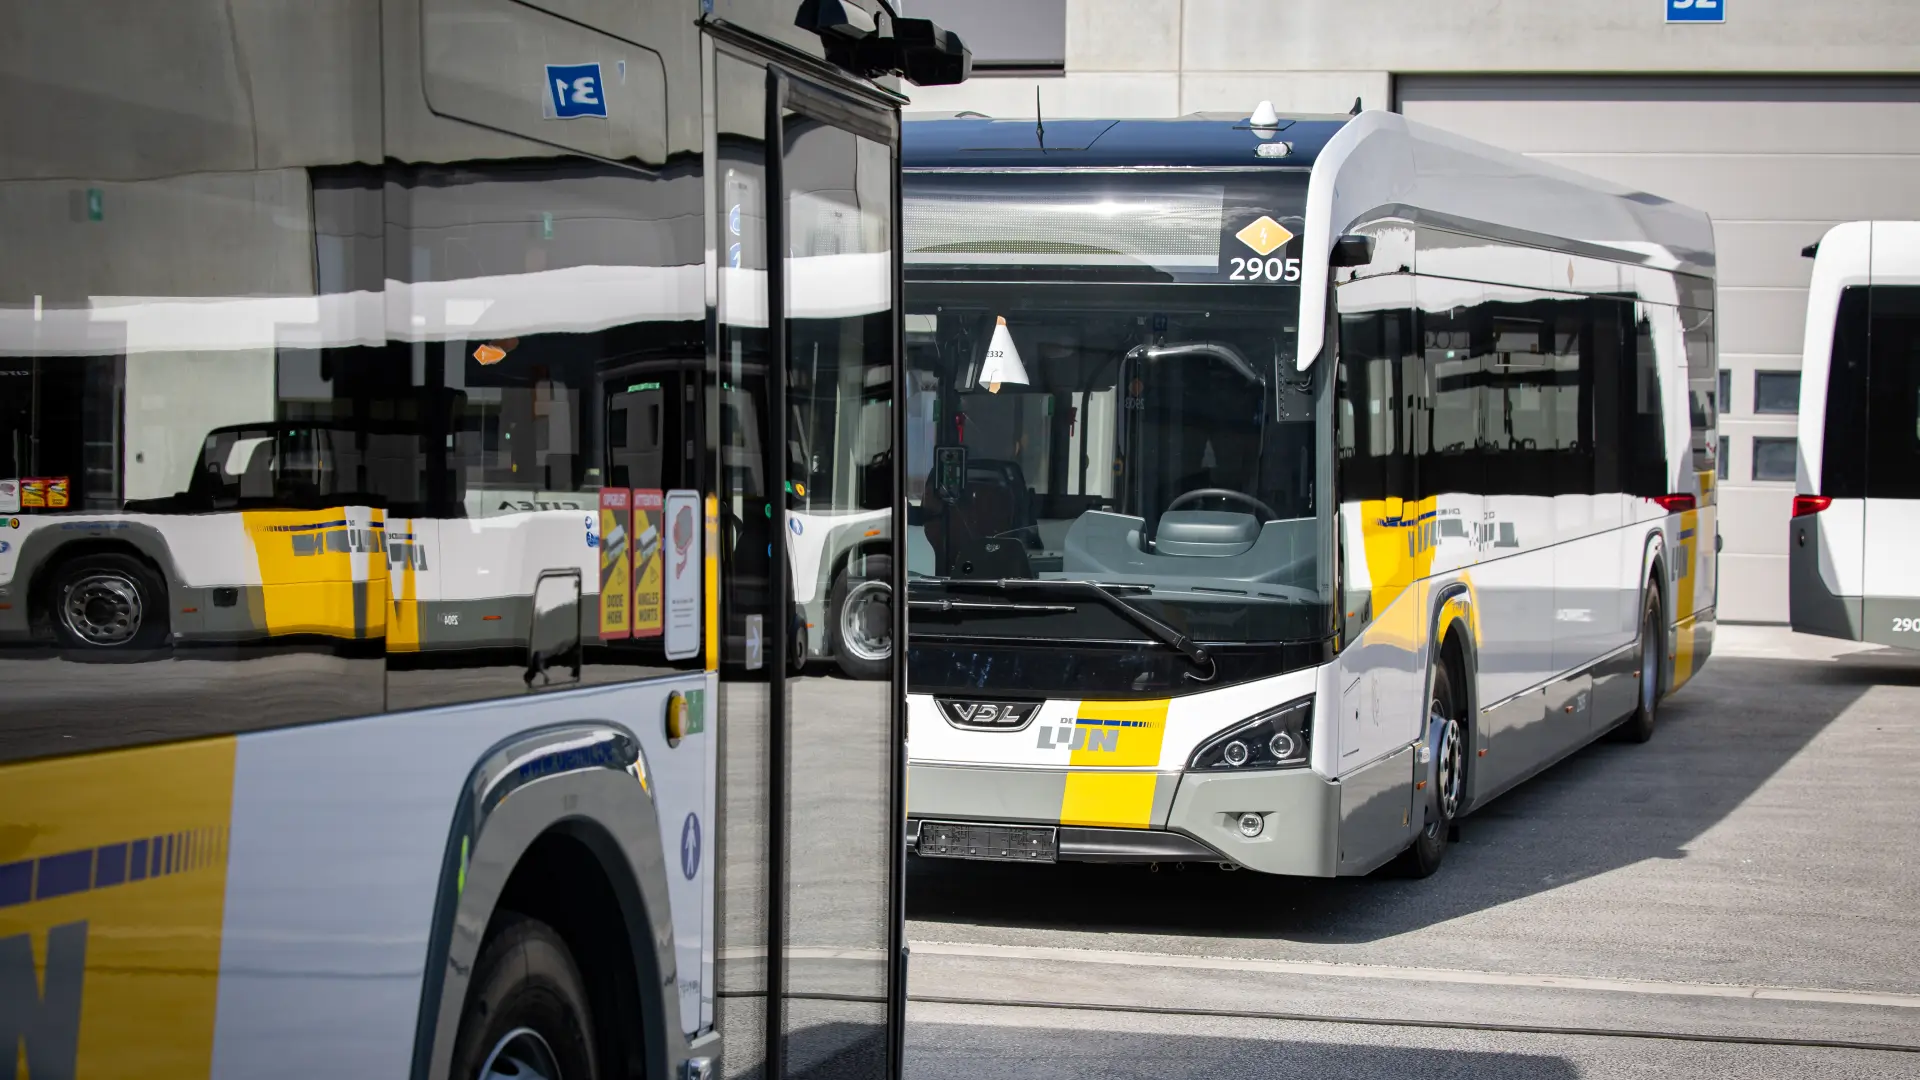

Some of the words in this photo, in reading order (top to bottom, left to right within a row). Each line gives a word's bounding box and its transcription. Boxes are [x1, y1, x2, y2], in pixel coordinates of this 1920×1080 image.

[1229, 257, 1301, 281] 2905
[953, 703, 1021, 724] VDL
[1060, 717, 1074, 725] DE
[1036, 725, 1120, 753] LIJN
